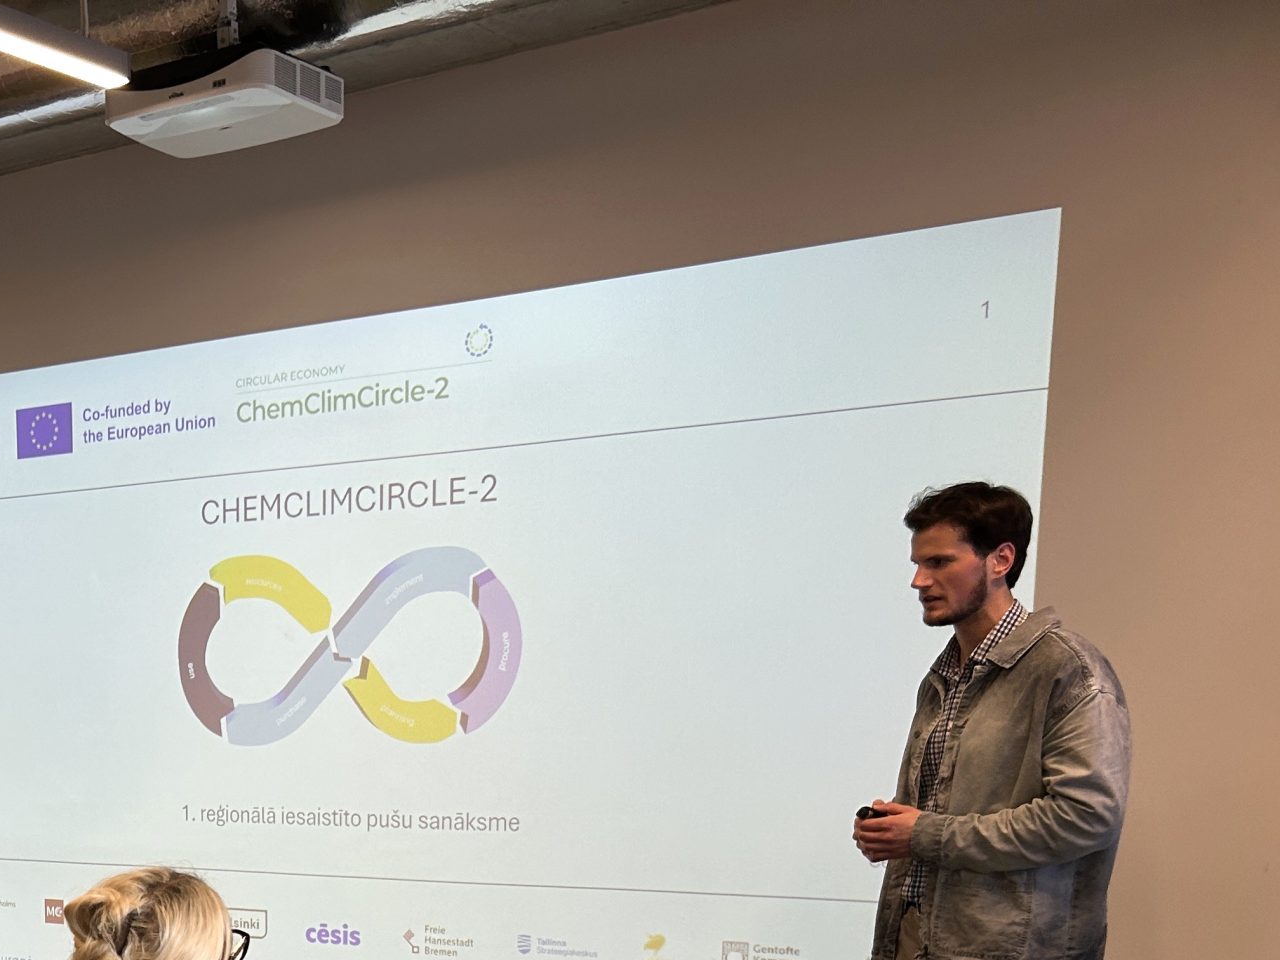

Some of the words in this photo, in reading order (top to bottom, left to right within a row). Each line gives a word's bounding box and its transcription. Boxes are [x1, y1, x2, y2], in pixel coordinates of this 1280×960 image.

[981, 300, 989, 319] 1
[235, 373, 287, 389] CIRCULAR
[290, 364, 346, 382] ECONOMY
[82, 401, 151, 422] Co-funded
[154, 398, 171, 416] by
[236, 376, 449, 423] ChemClimCircle-2
[83, 429, 104, 444] the
[107, 422, 171, 442] European
[175, 416, 216, 432] Union
[201, 474, 498, 525] CHEMCLIMCIRCLE-2
[181, 804, 196, 823] 1.
[200, 804, 276, 827] reģionālā
[280, 806, 362, 828] iesaistīto
[366, 809, 413, 832] pušu
[417, 811, 520, 832] sanāksme
[229, 917, 261, 930] lsinki
[424, 924, 447, 935] Freie
[304, 923, 361, 947] cēsis
[424, 935, 475, 948] Hansestadt
[536, 938, 567, 947] Tallinna
[424, 946, 459, 957] Bremen
[752, 944, 801, 957] Gentofte
